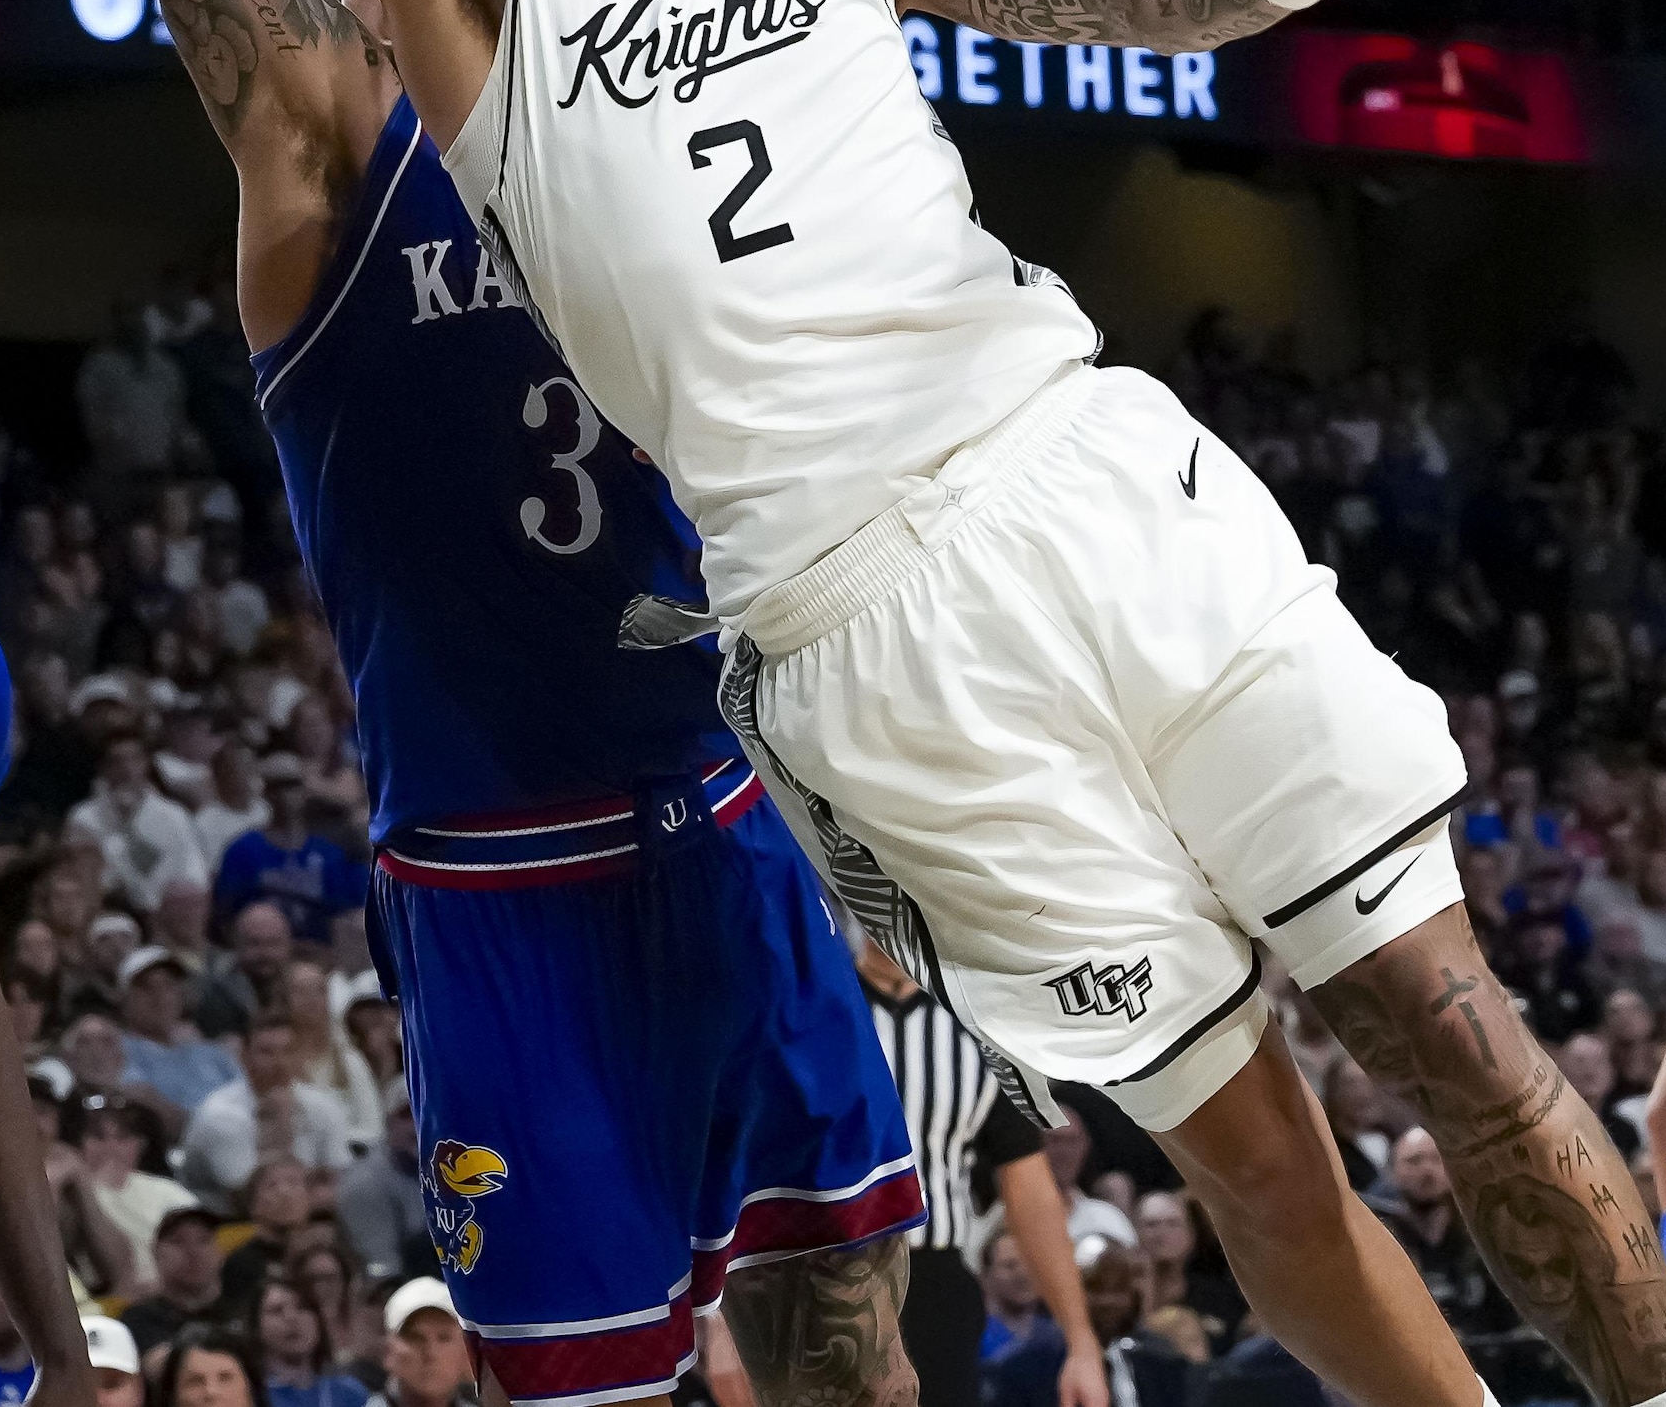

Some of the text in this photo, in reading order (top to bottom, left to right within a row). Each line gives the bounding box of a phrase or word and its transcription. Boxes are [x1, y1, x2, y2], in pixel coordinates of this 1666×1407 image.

[686, 118, 795, 264] 2
[519, 376, 604, 555] 3
[1040, 955, 1153, 1024] UCF
[1556, 1134, 1595, 1179] HA
[435, 1206, 456, 1234] KU
